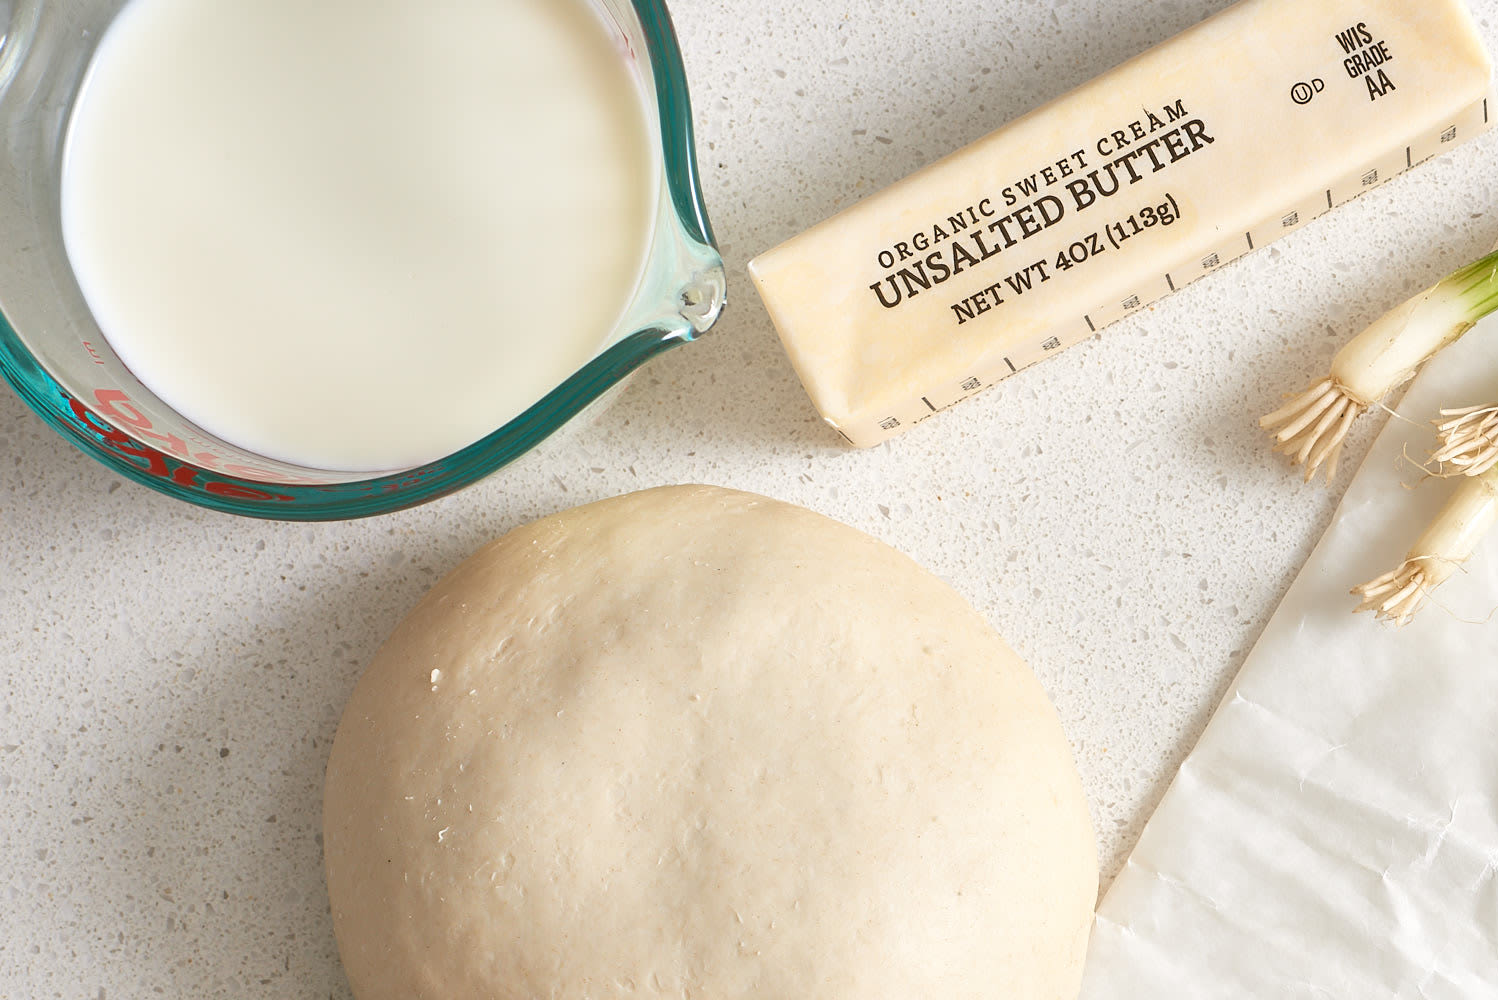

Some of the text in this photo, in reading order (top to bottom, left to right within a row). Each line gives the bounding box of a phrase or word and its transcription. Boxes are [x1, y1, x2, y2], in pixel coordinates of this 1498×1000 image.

[1335, 22, 1373, 54] WIS
[1343, 40, 1393, 79] GRADE
[1364, 68, 1396, 101] AA
[869, 118, 1215, 309] UNSALTED BUTTER
[877, 99, 1189, 269] ORGANIC SWEET CREAM
[950, 283, 1004, 325] NET
[1005, 259, 1052, 297] WT
[1105, 192, 1181, 250] (113g)
